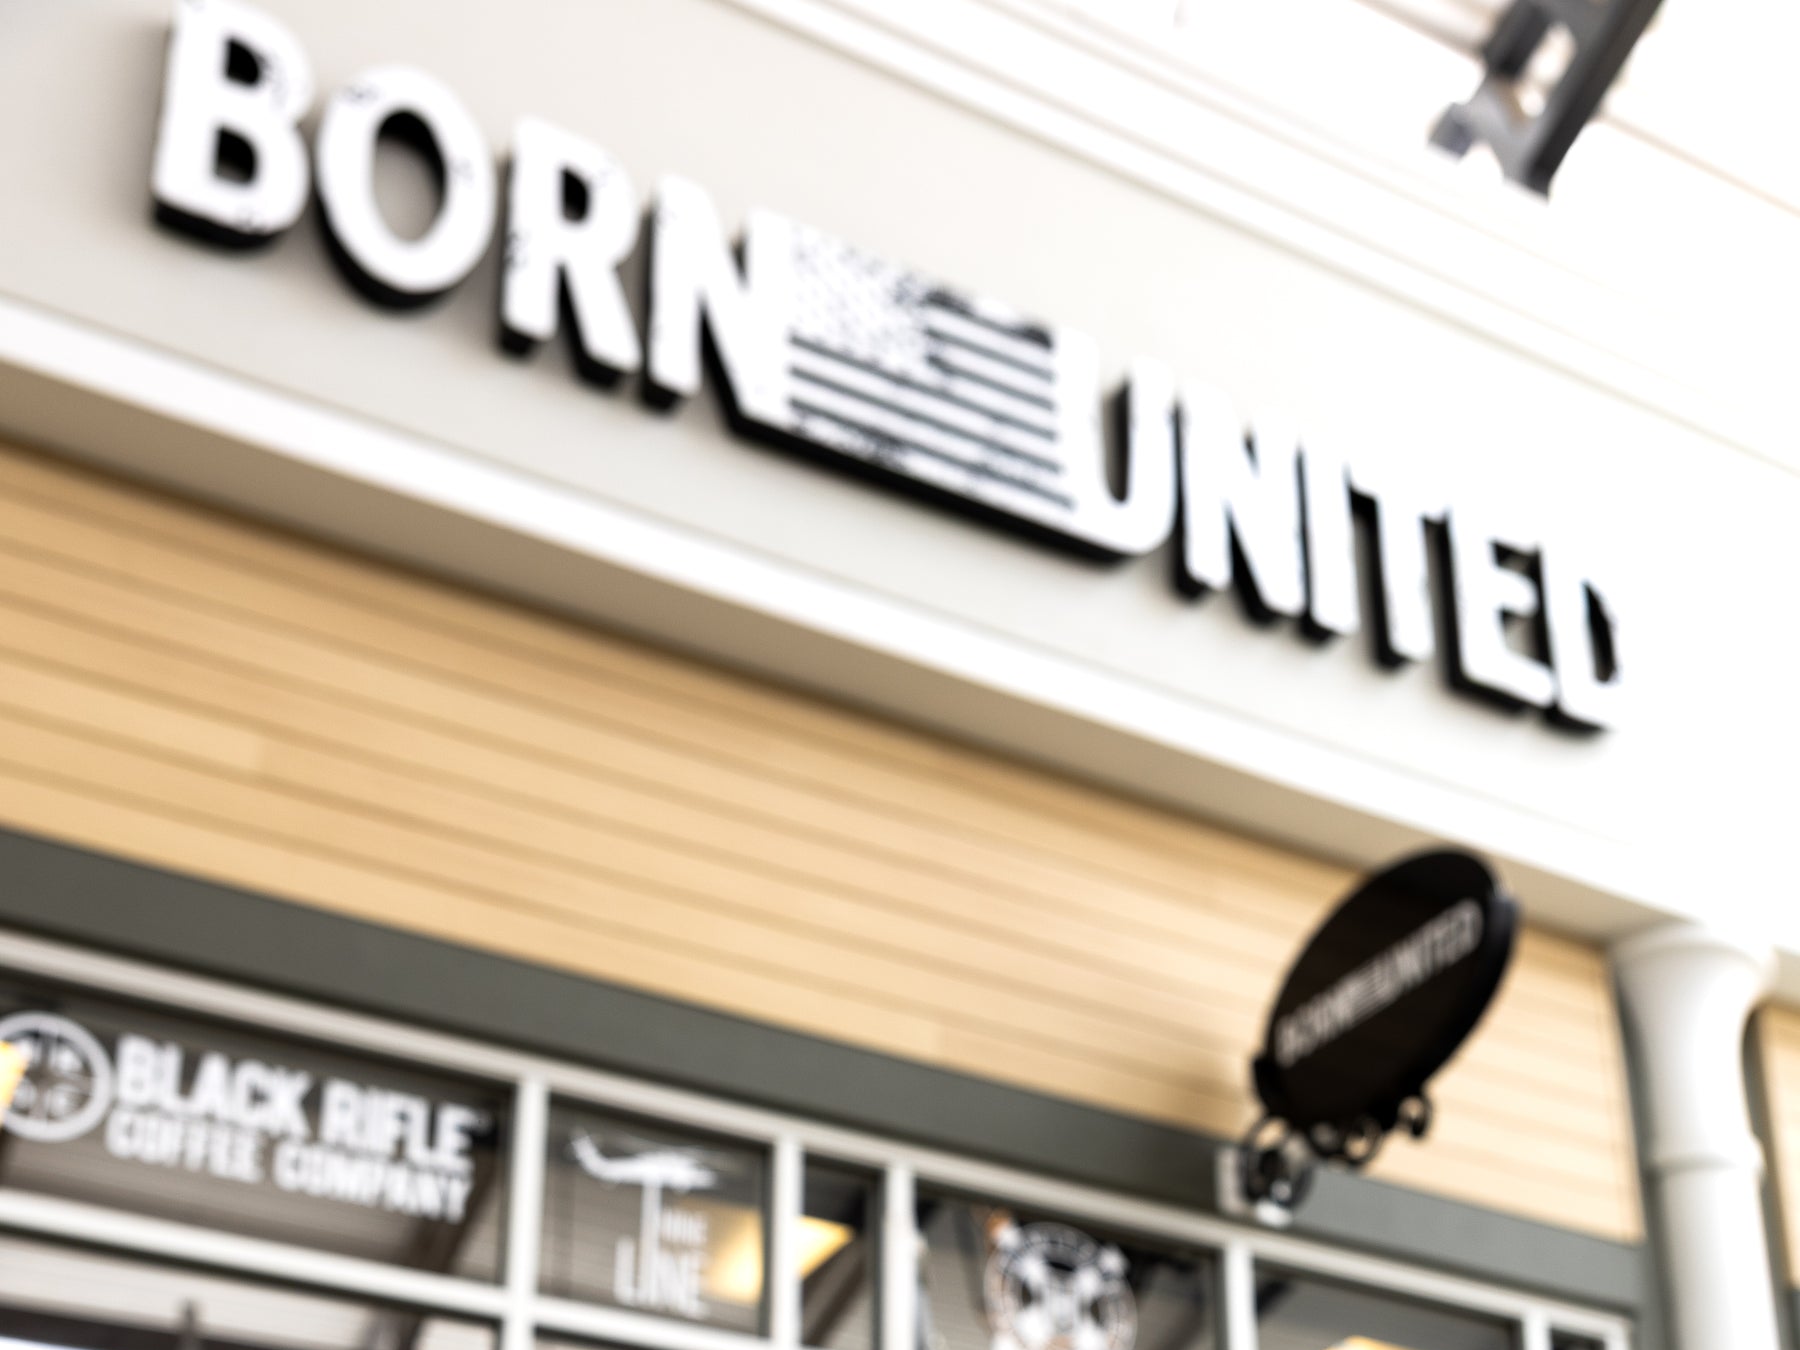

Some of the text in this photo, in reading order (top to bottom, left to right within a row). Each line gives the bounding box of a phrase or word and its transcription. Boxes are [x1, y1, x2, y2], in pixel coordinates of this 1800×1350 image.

[152, 0, 1622, 735] BORN UNITED
[106, 1105, 474, 1225] COFFEE COMPANY
[114, 1032, 472, 1175] BLACK RIFLE
